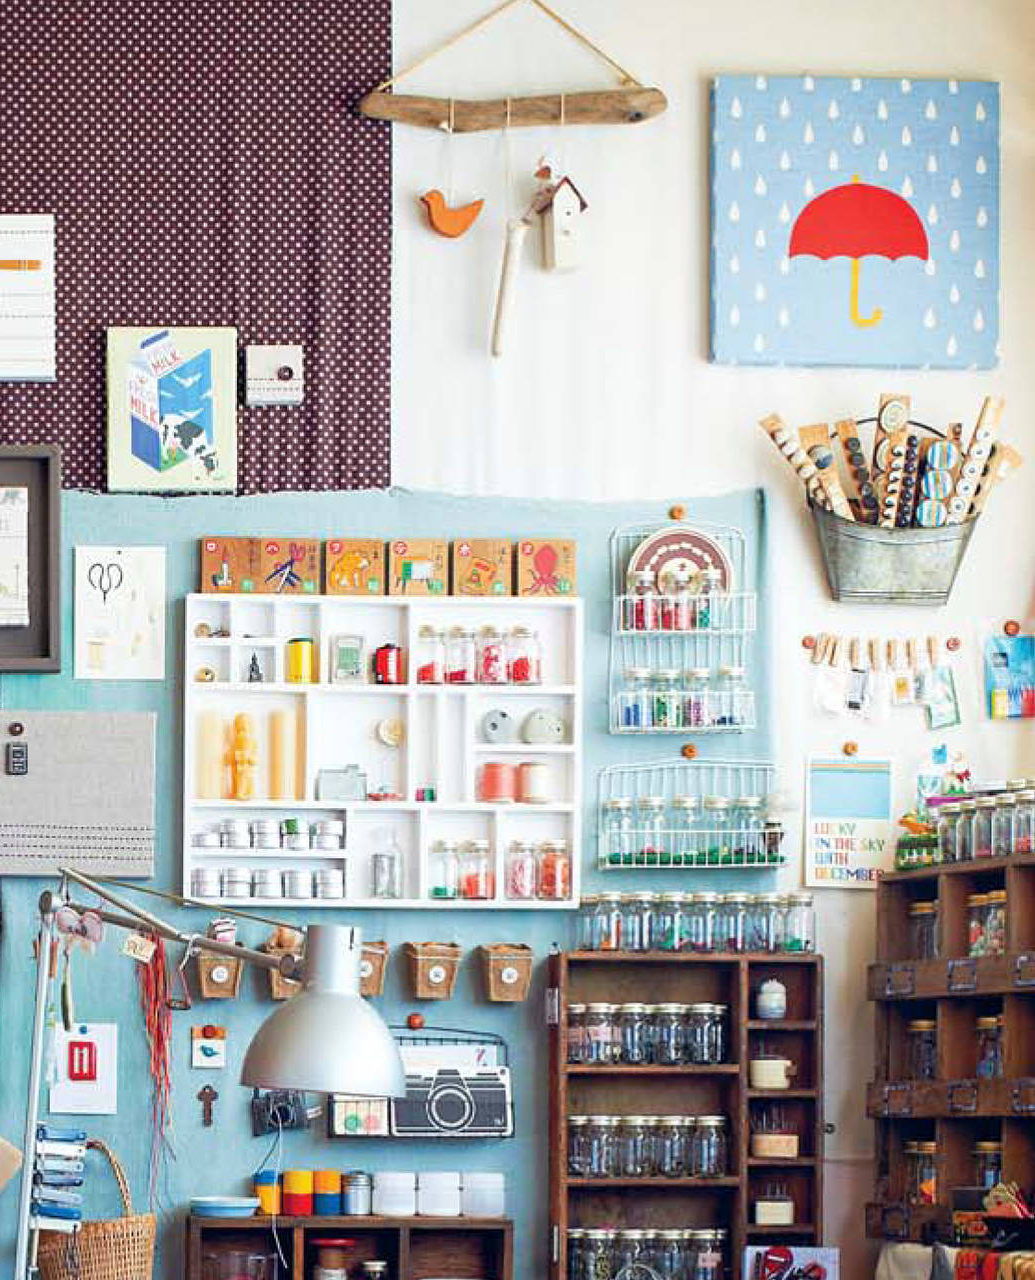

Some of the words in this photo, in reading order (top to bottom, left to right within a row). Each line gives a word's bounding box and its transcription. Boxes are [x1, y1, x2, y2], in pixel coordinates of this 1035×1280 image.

[130, 398, 157, 425] MILK
[834, 838, 857, 851] THE
[860, 838, 885, 852] SKY
[815, 867, 885, 880] DECEMBER
